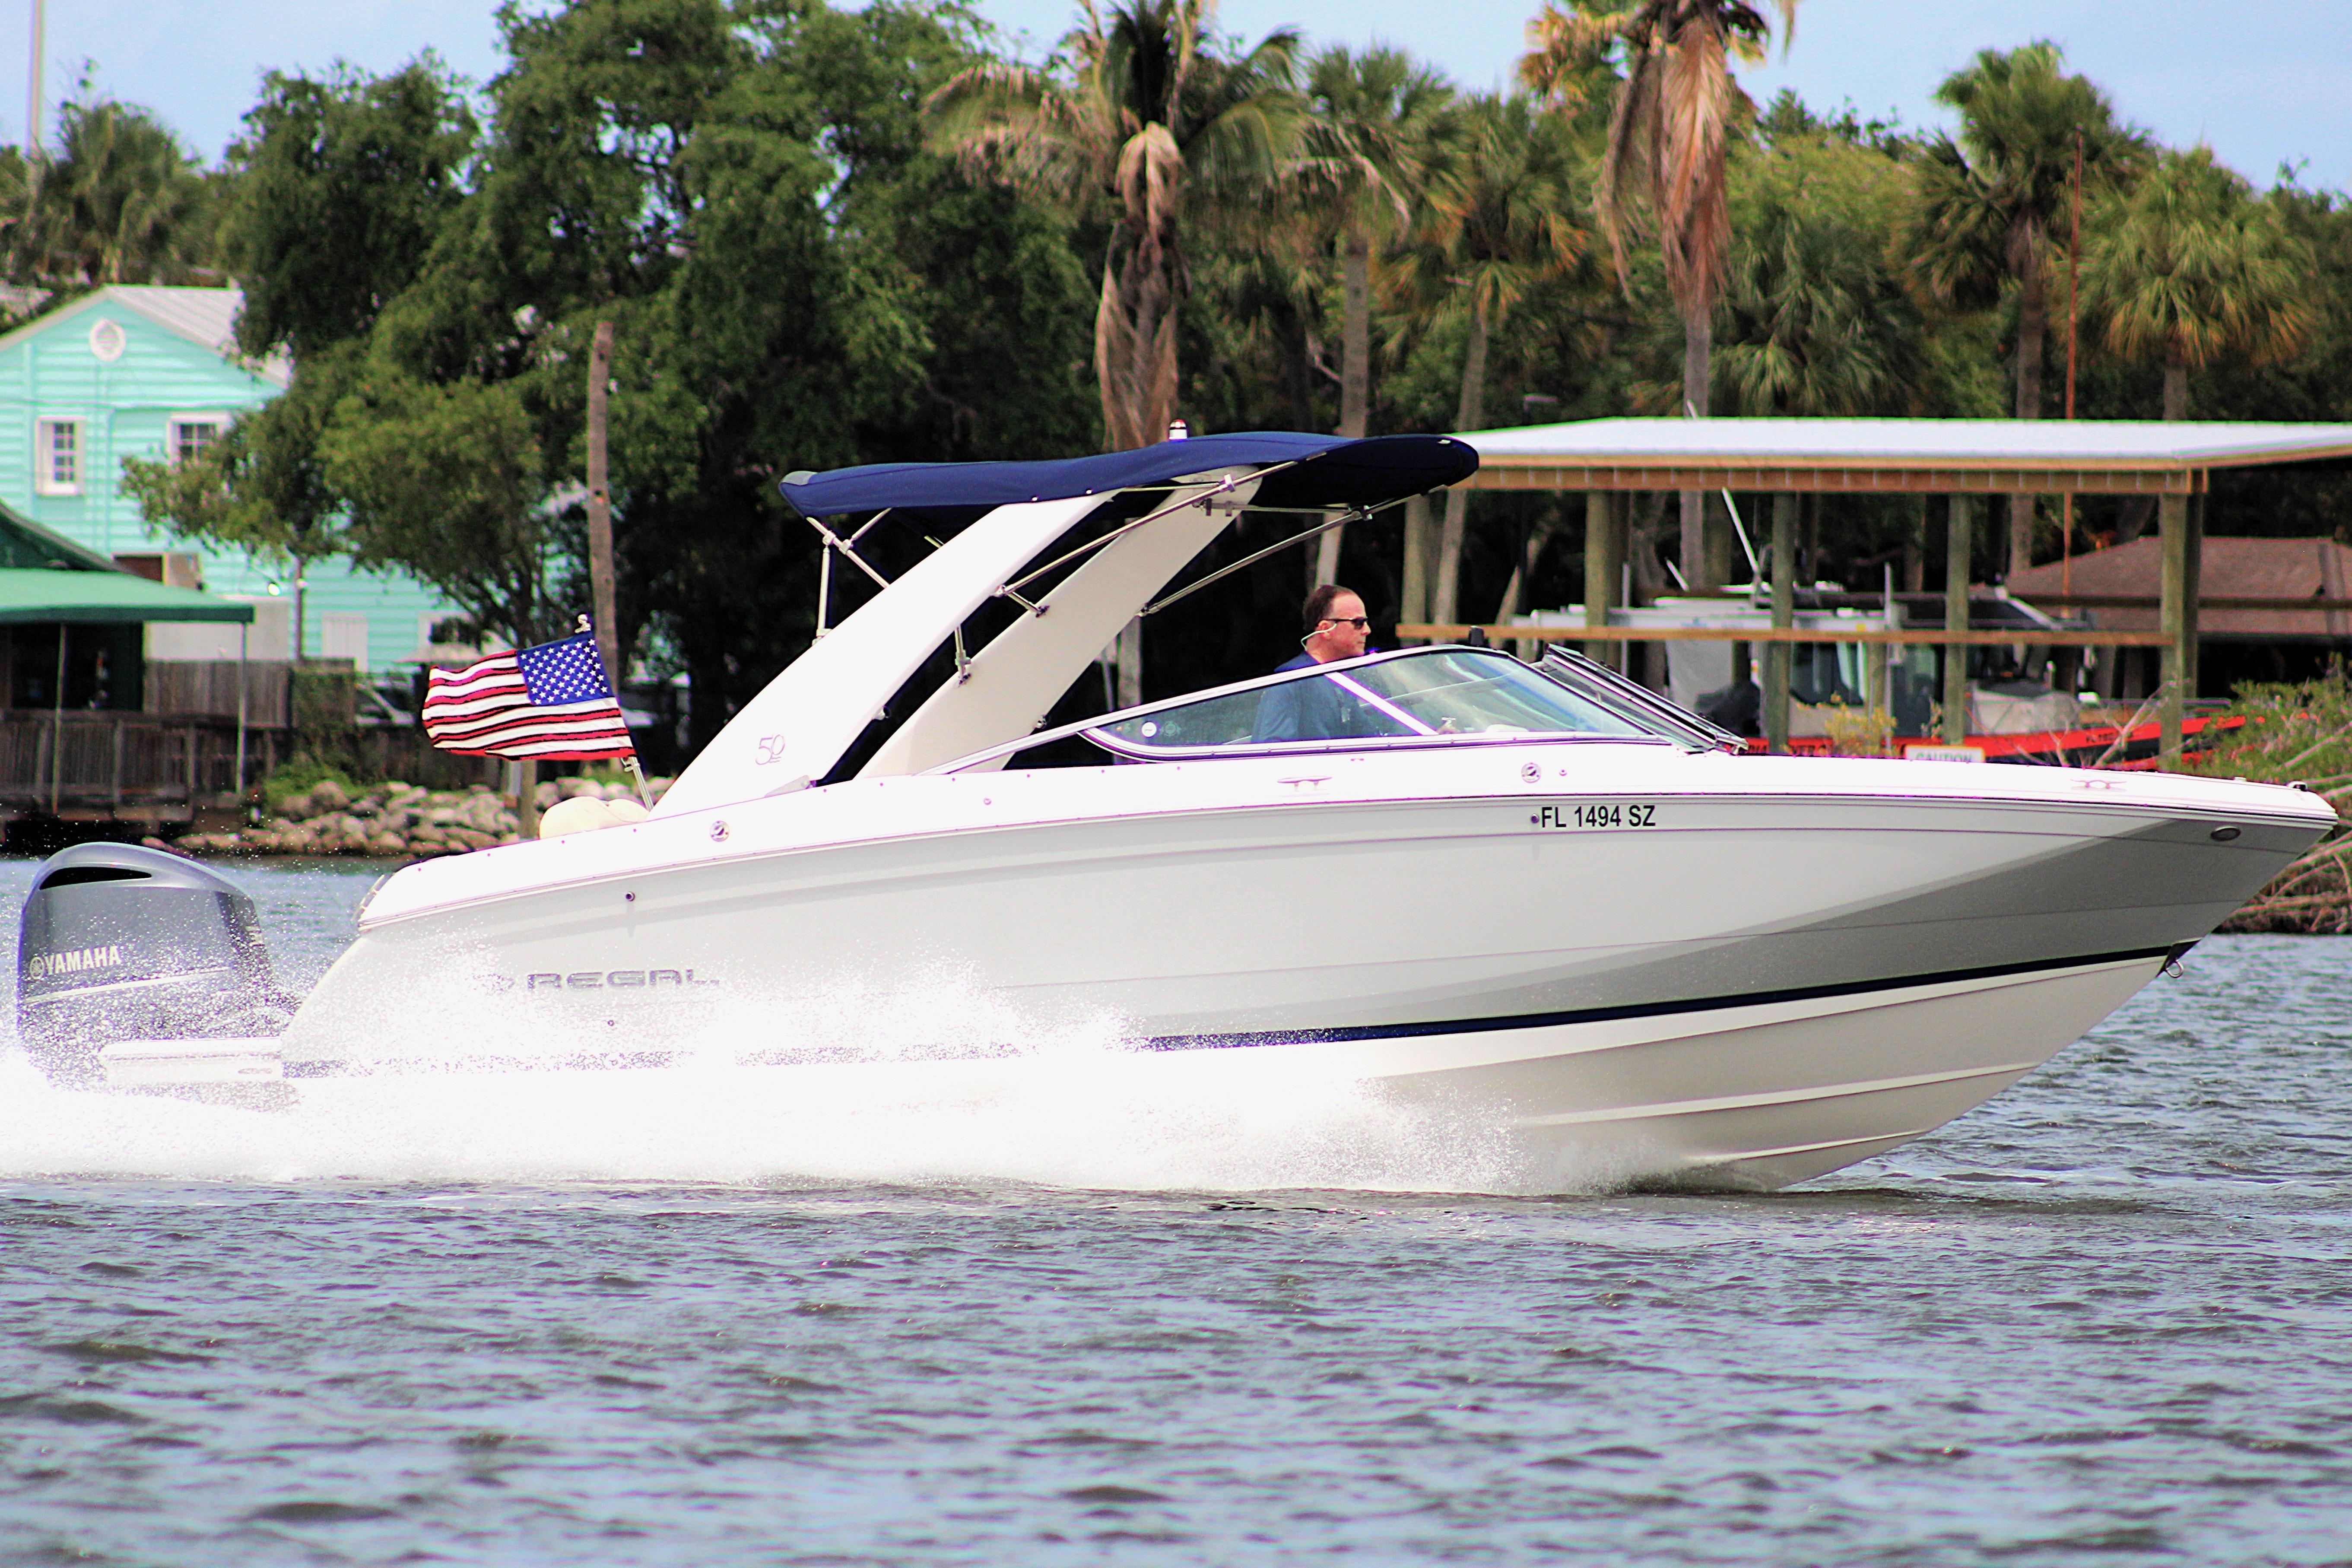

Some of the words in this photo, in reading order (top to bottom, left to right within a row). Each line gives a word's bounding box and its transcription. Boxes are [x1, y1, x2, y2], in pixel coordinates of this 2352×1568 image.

[1542, 806, 1566, 828] FL
[1574, 806, 1621, 827] 1494
[1628, 805, 1656, 826] SZ
[44, 945, 121, 975] YAMAHA
[527, 969, 719, 990] REGAL
